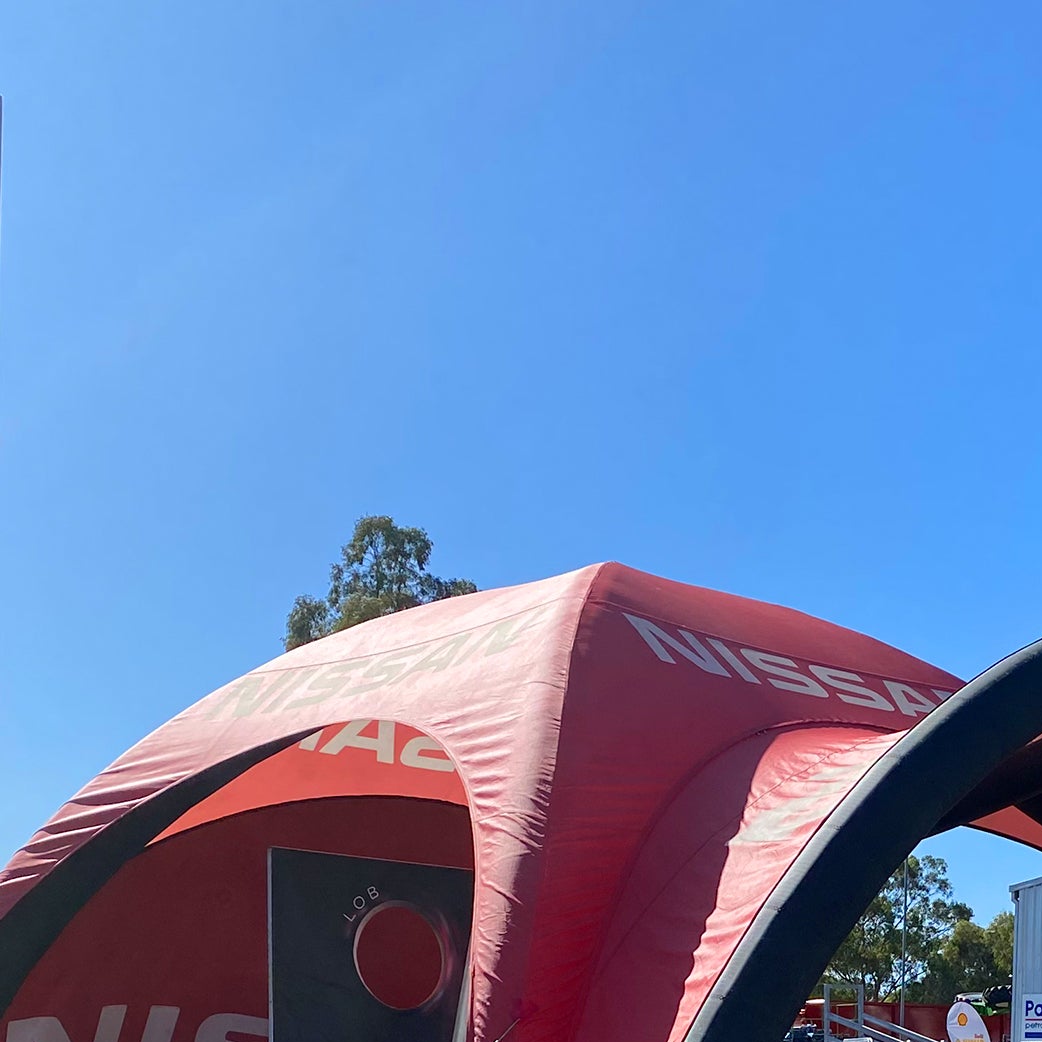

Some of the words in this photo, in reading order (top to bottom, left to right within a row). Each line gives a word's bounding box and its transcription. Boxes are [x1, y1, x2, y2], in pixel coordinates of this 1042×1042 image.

[203, 610, 542, 722] NISSAN
[622, 612, 958, 717] NISSA
[343, 886, 379, 922] LOB
